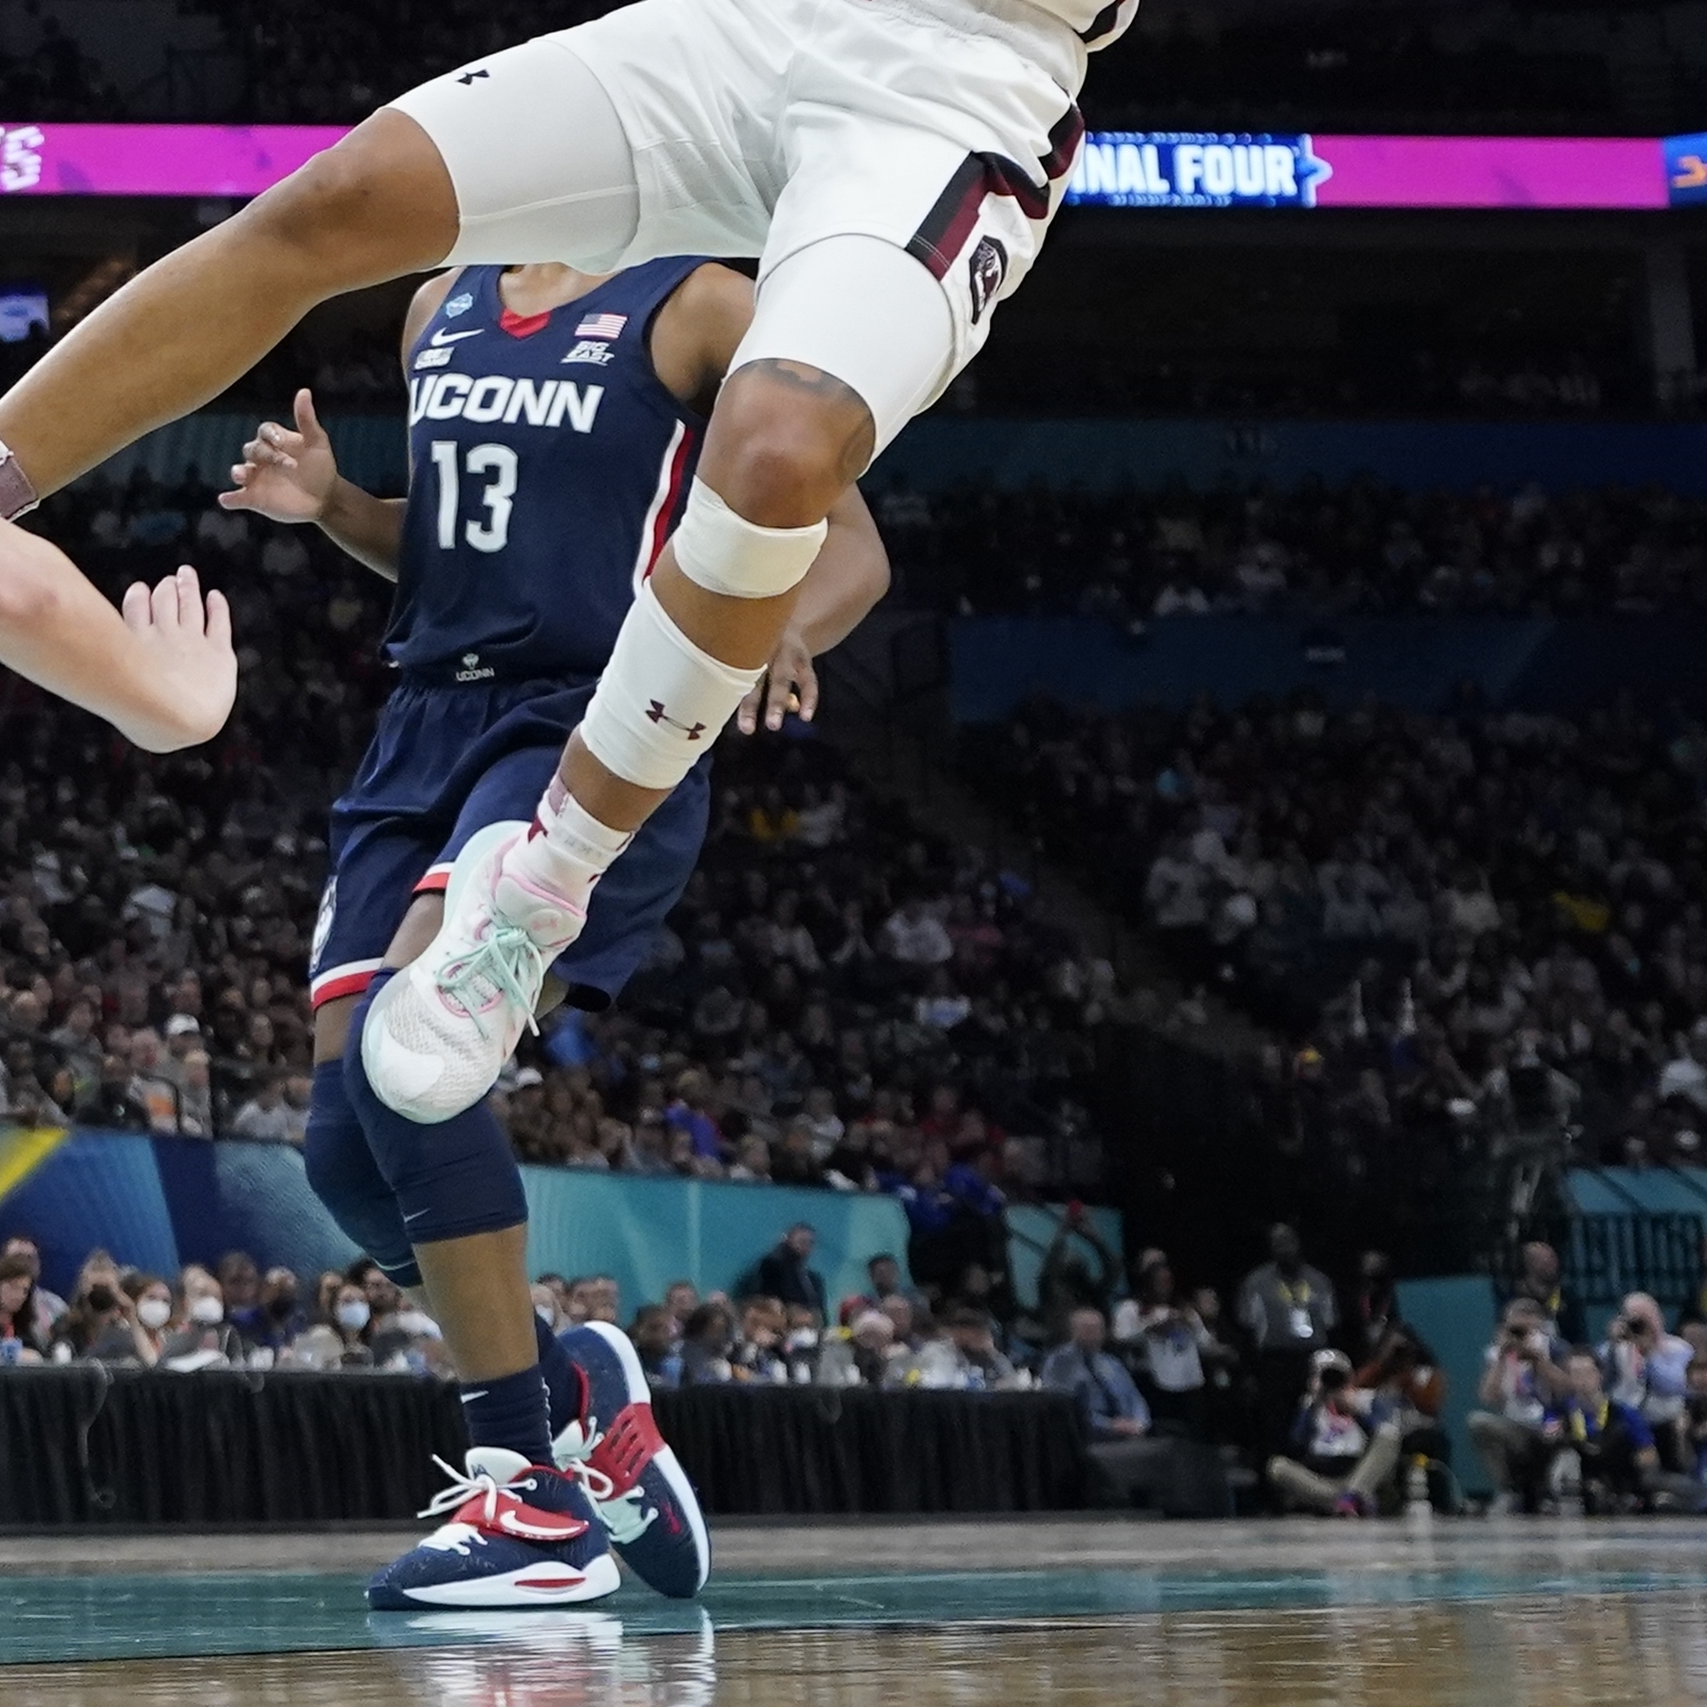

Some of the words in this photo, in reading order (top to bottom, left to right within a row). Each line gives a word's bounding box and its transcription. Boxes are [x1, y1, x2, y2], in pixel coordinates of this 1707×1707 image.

[1173, 145, 1298, 196] FOUR
[409, 373, 605, 434] UCONN
[431, 440, 519, 553] 13
